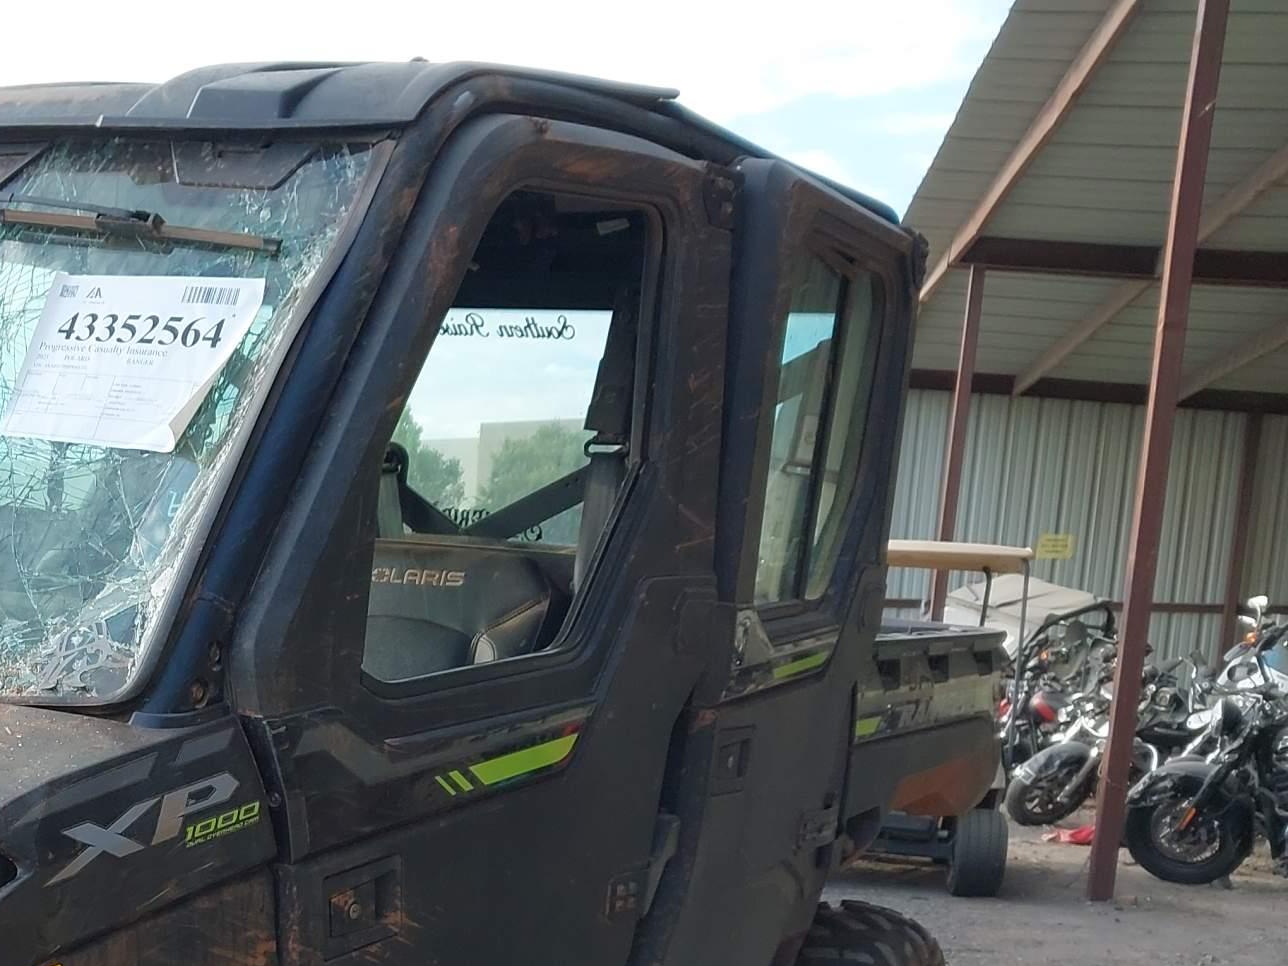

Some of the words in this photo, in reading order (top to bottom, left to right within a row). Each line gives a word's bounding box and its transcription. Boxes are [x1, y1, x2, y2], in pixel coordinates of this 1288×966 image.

[58, 311, 226, 349] 43352564
[39, 341, 85, 353] Progressive
[88, 343, 123, 356] Casualty
[126, 345, 169, 358] Insurance
[371, 567, 466, 587] OLARIS
[43, 771, 240, 888] XP
[184, 800, 260, 843] 1000
